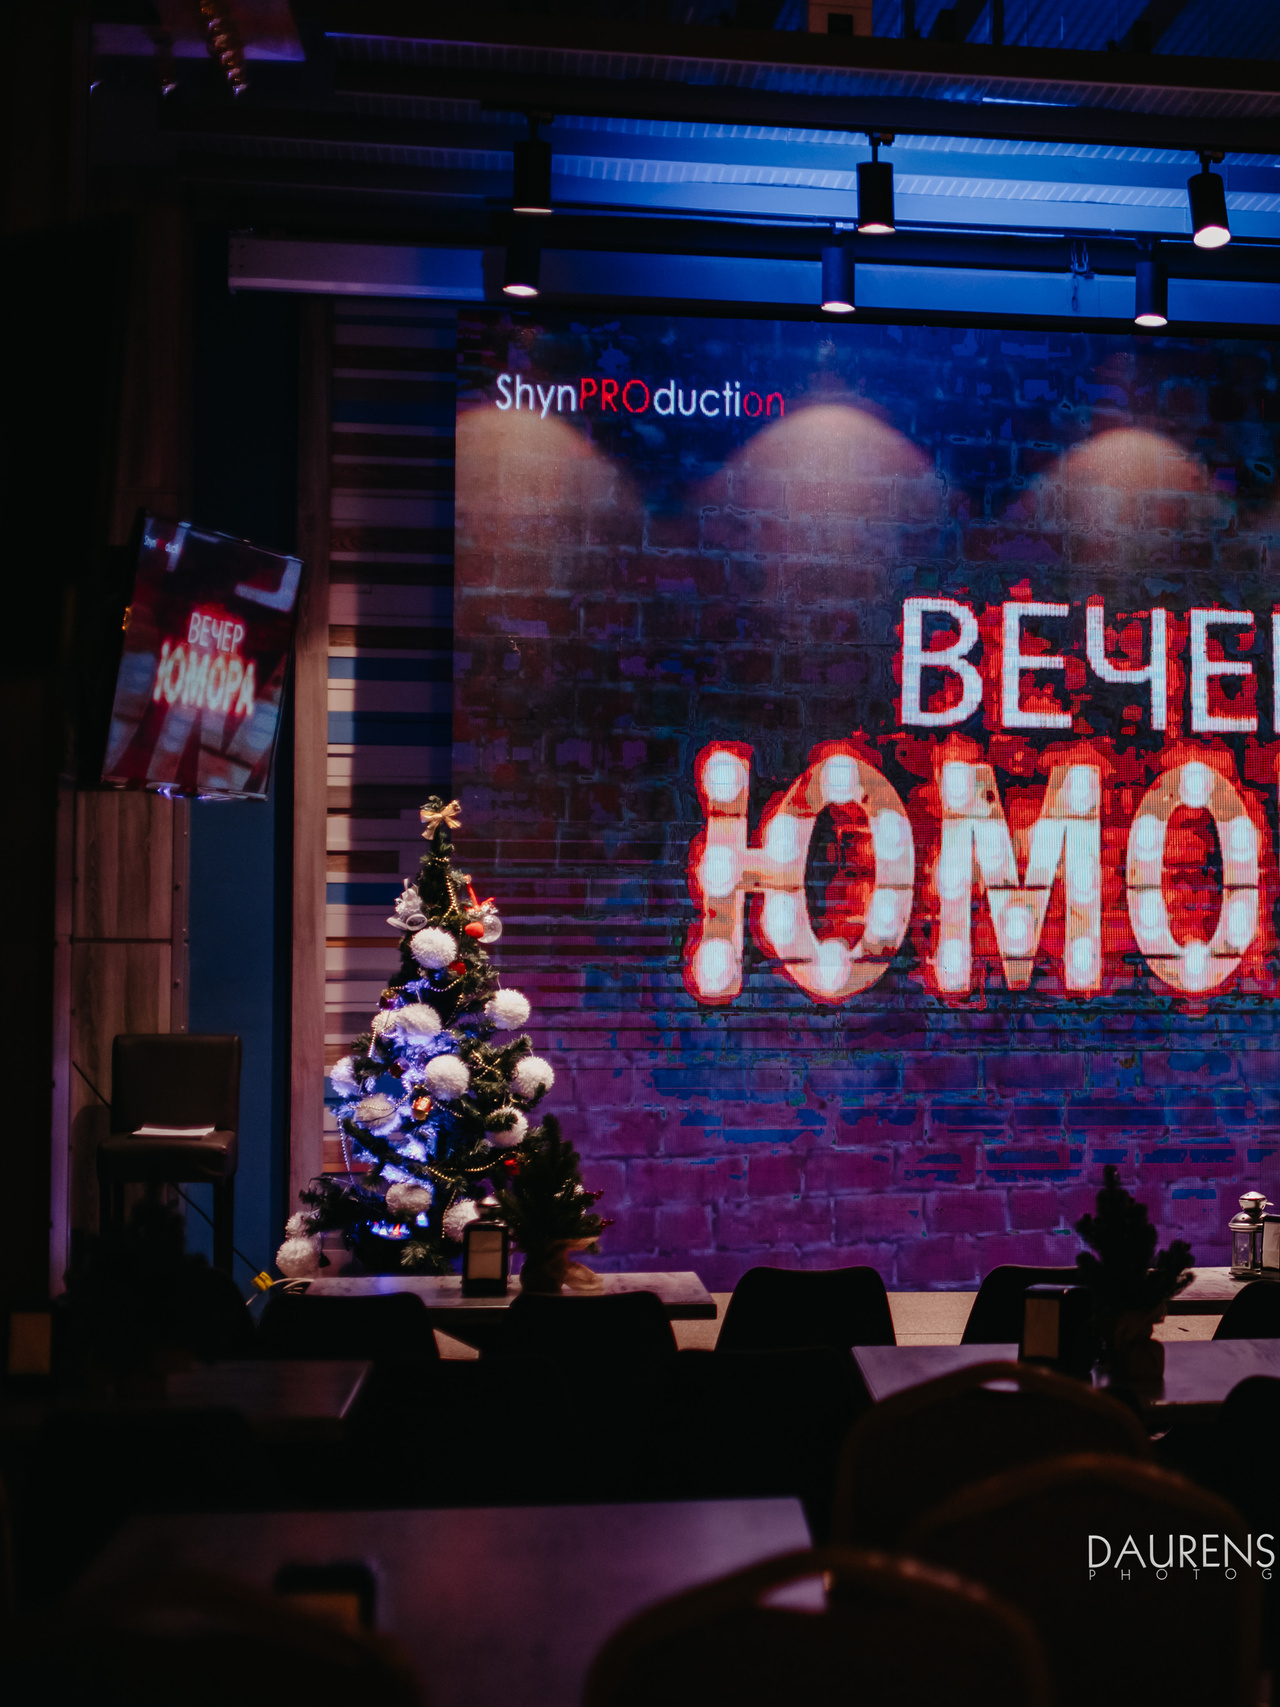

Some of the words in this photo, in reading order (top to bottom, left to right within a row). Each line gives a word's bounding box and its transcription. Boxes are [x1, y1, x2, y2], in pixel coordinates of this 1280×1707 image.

[495, 373, 785, 419] ShynPROduction
[188, 612, 244, 652] ВЕЧЕР
[154, 641, 255, 715] ЮМОРА
